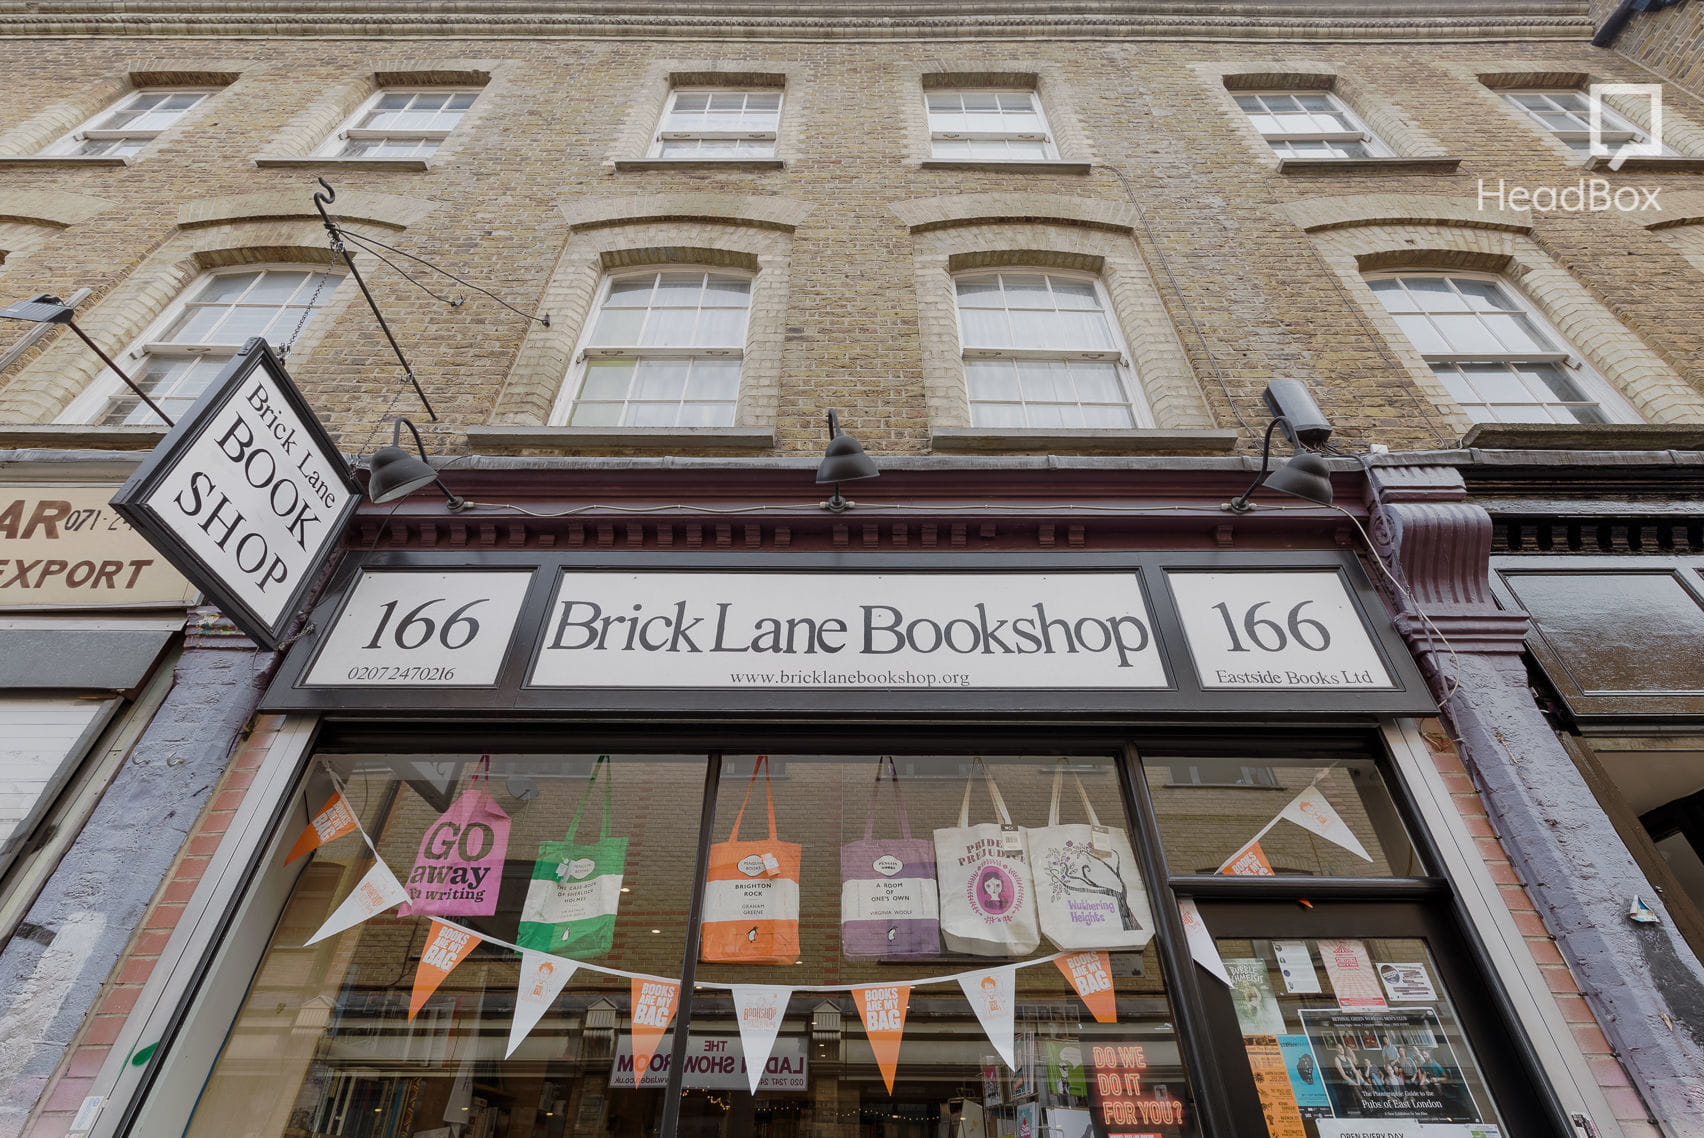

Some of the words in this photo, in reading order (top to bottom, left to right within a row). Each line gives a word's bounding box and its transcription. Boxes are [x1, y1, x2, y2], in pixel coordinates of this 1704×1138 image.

[245, 380, 297, 456] Brick
[297, 449, 335, 509] Lane
[214, 411, 321, 552] BOOK
[173, 471, 288, 594] SHOP
[362, 598, 490, 650] 166
[546, 599, 704, 653] Brick
[709, 602, 847, 654] Lane
[859, 602, 1149, 668] Bookshop
[1211, 600, 1331, 652] 166
[730, 670, 970, 687] www.bricklanebookshop.org
[1216, 670, 1282, 684] Eastside
[1285, 671, 1339, 685] Books
[1340, 670, 1374, 684] Ltd
[424, 821, 495, 862] GO
[966, 838, 1003, 854] PRIDE
[410, 865, 491, 890] away
[426, 888, 486, 903] writing
[1068, 900, 1115, 913] Wuthering
[1070, 911, 1105, 926] Heights
[422, 944, 458, 971] BAG
[865, 988, 898, 1001] BOOKS
[1075, 970, 1111, 997] BAG
[633, 1004, 669, 1027] BAG
[867, 1010, 902, 1032] BAG
[1093, 1046, 1117, 1069] DO
[1118, 1046, 1146, 1069] WE
[1097, 1073, 1121, 1096] DO
[1124, 1073, 1140, 1096] IT
[1102, 1101, 1137, 1125] FOR
[1137, 1100, 1182, 1125] YOU?
[1361, 1100, 1382, 1110] Pubs
[1383, 1099, 1392, 1109] of
[1393, 1099, 1411, 1109] East
[1411, 1099, 1443, 1109] London
